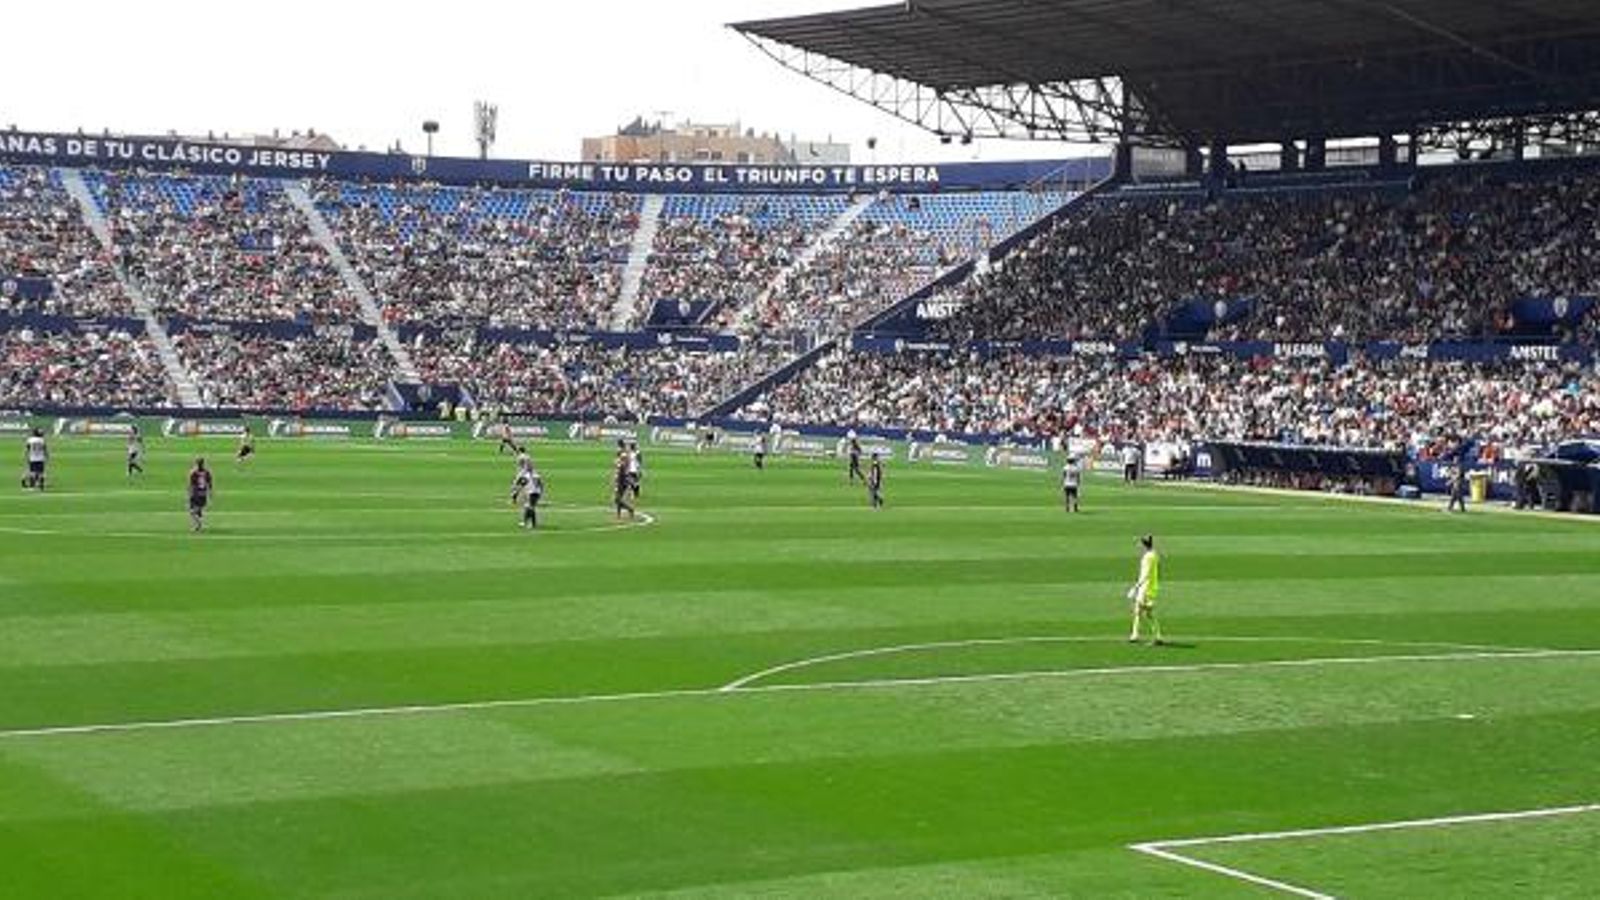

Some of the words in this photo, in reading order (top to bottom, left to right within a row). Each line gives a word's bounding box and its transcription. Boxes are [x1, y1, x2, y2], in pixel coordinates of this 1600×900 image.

[66, 139, 97, 156] DE
[105, 142, 133, 158] TU
[142, 143, 241, 165] CLÁSICO
[248, 149, 330, 170] JERSEY
[528, 164, 593, 180] FIRME
[601, 166, 629, 182] TU
[636, 167, 692, 182] PASO
[703, 168, 728, 182] EL
[735, 168, 826, 183] TRIUNFO
[831, 168, 856, 182] TE
[862, 167, 939, 182] ESPERA
[1510, 345, 1559, 360] AMSTEL
